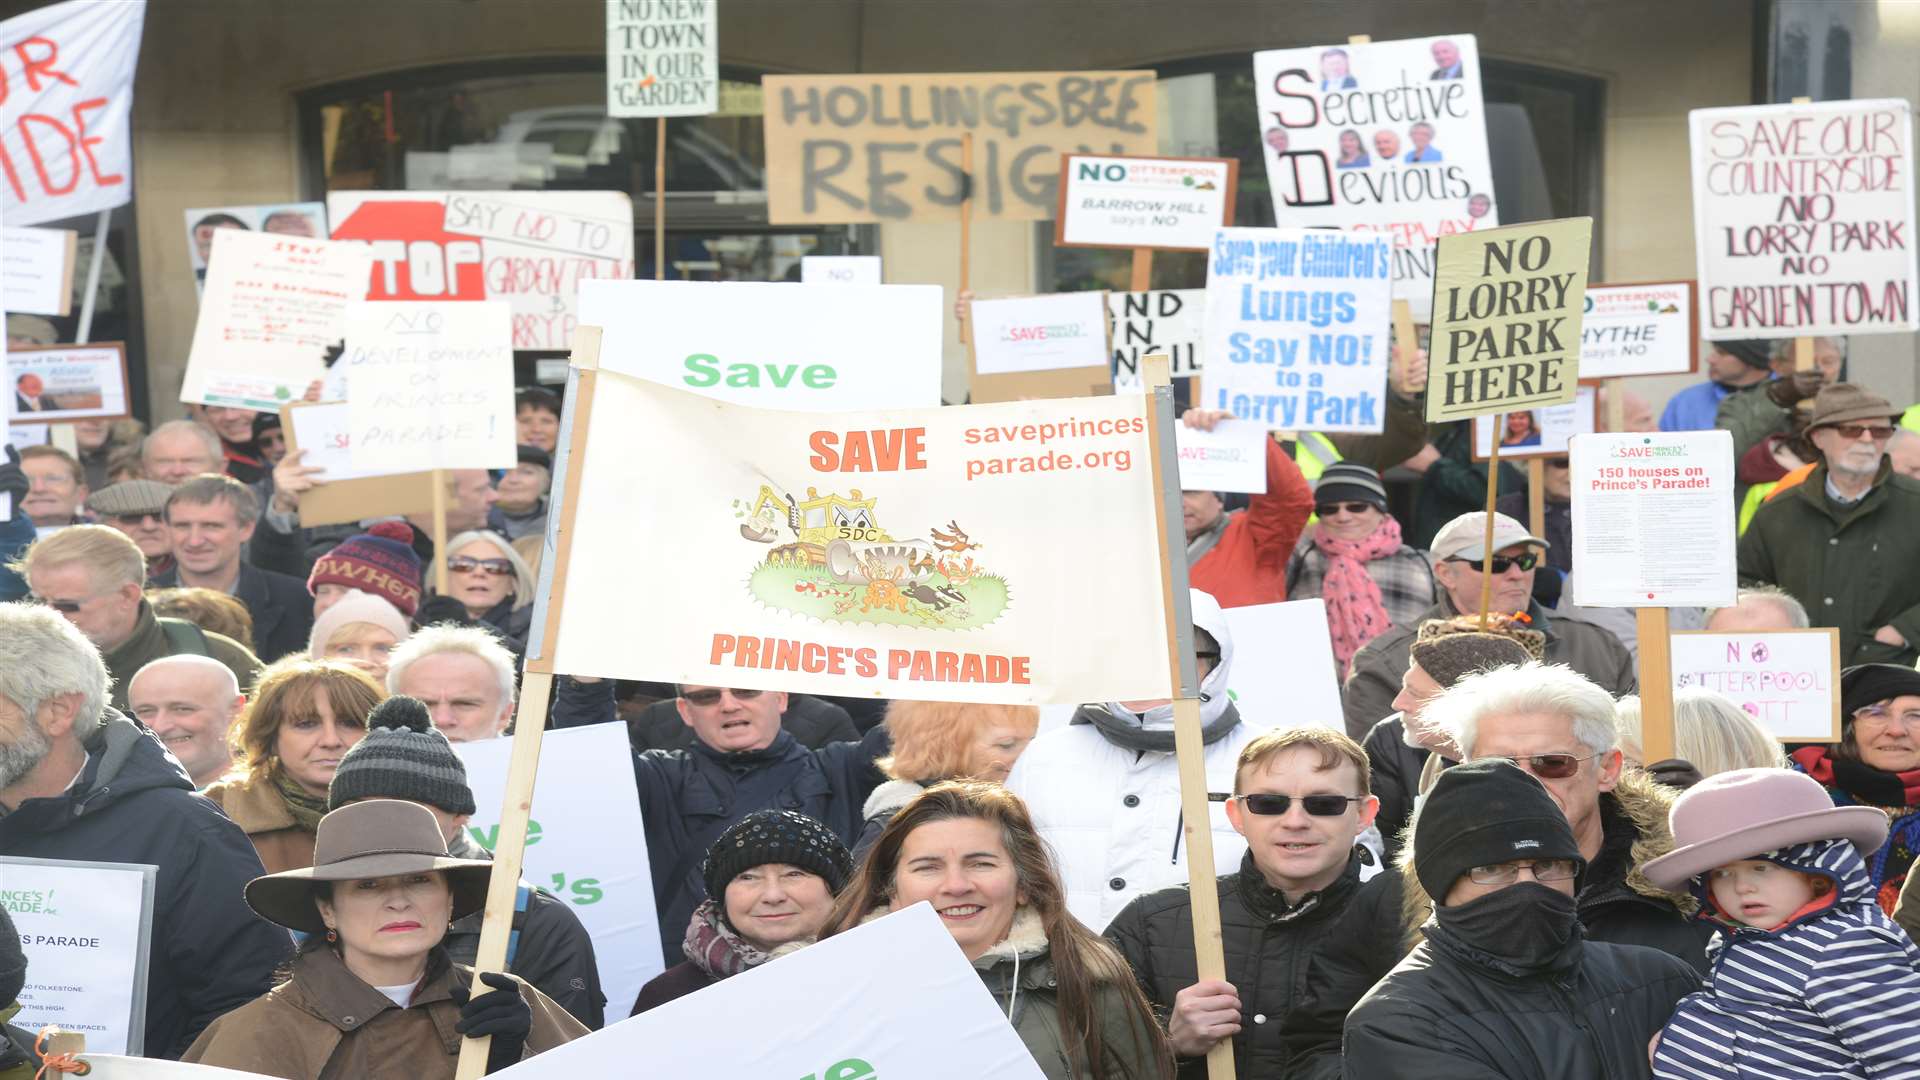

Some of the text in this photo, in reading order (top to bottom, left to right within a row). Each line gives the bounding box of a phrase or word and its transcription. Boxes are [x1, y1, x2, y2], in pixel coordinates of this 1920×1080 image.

[619, 0, 705, 20] NO NEW
[617, 22, 706, 50] TOWN
[0, 36, 80, 106] R
[621, 52, 705, 80] IN OUR
[780, 75, 1157, 138] HOLLINGSBEE
[1269, 68, 1469, 129] Secretive
[1710, 110, 1901, 160] SAVE OUR
[801, 138, 1124, 219] RESIG
[1078, 163, 1127, 182] NO
[1278, 150, 1472, 208] Devious
[1706, 154, 1904, 197] COUNTRYSIDE
[1081, 197, 1209, 215] BARROW HILL
[1150, 214, 1180, 227] NO
[1776, 193, 1835, 223] NO
[446, 197, 611, 252] SAY NO TO
[1722, 220, 1907, 258] LORRY PARK
[366, 239, 483, 297] TOP
[1481, 235, 1552, 278] NO
[1780, 254, 1830, 276] NO
[1109, 290, 1183, 318] ND
[1240, 283, 1358, 328] Lungs
[1445, 272, 1577, 323] LORRY
[1709, 280, 1909, 329] GARDEN TOWN
[1009, 325, 1047, 341] SAVE
[1228, 332, 1374, 368] Say NO!
[1447, 316, 1567, 366] PARK
[1580, 325, 1658, 344] HYTHE
[1620, 343, 1648, 357] NO
[681, 352, 838, 390] Save
[1276, 370, 1324, 388] to a
[1443, 358, 1564, 407] HERE
[1306, 390, 1377, 426] Park
[809, 427, 928, 473] SAVE
[965, 449, 1132, 481] parade.org
[1619, 446, 1652, 458] SAVE
[1591, 477, 1711, 491] Prince's Parade!
[1598, 466, 1704, 479] 150 houses on
[838, 527, 878, 542] SDC
[709, 633, 1031, 685] PRINCE'S PARADE
[468, 818, 544, 851] ve
[1, 889, 43, 902] NCE'S
[36, 935, 100, 948] PARADE
